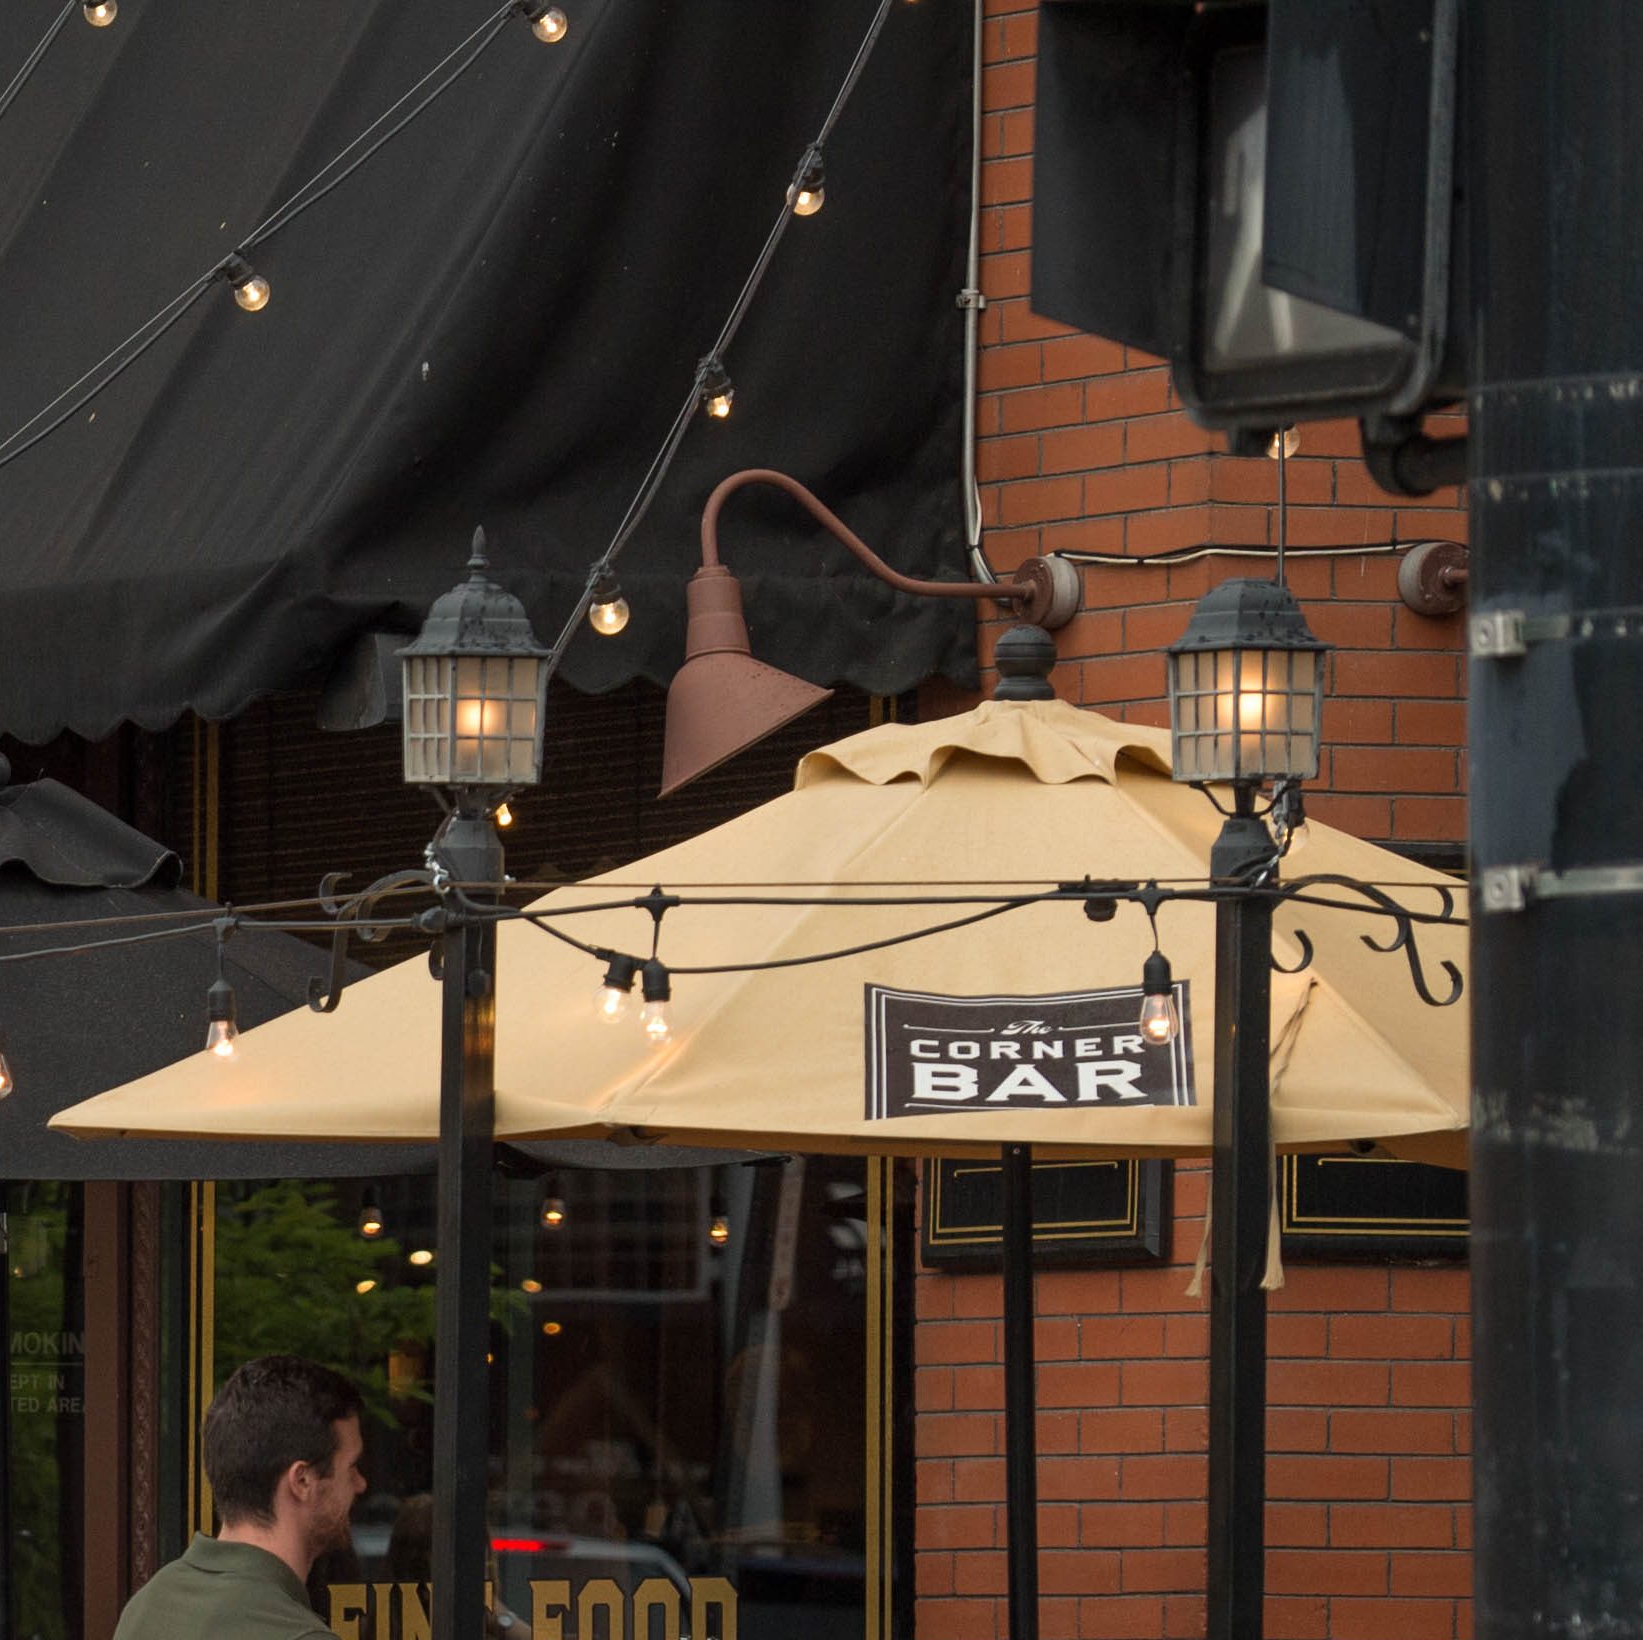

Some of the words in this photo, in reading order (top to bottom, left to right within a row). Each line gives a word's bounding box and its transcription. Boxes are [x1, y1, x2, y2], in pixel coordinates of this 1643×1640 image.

[1001, 1020, 1053, 1036] The
[910, 1034, 1146, 1060] CORNER
[913, 1059, 1148, 1101] BAR
[11, 1331, 84, 1355] MOKIN
[47, 1396, 82, 1413] ARE
